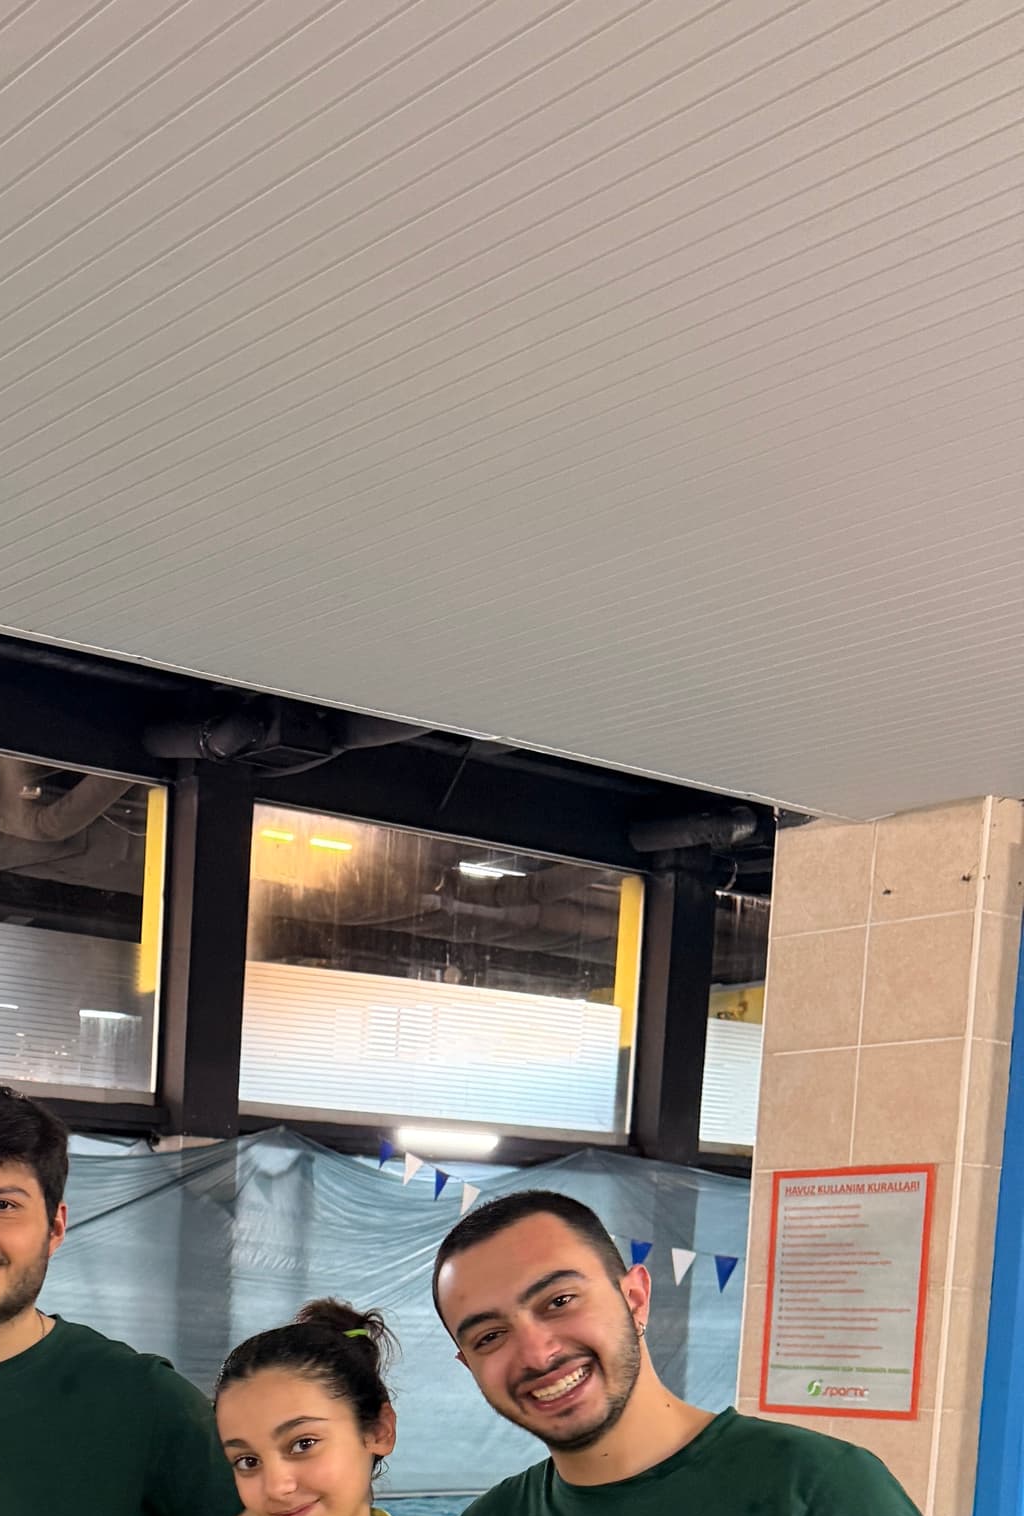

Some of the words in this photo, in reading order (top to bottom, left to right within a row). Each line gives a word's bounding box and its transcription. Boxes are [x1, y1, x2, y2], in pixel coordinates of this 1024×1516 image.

[785, 1185, 815, 1197] HAVUZ
[817, 1183, 865, 1195] KULLANIM
[867, 1181, 920, 1193] KURALLARI
